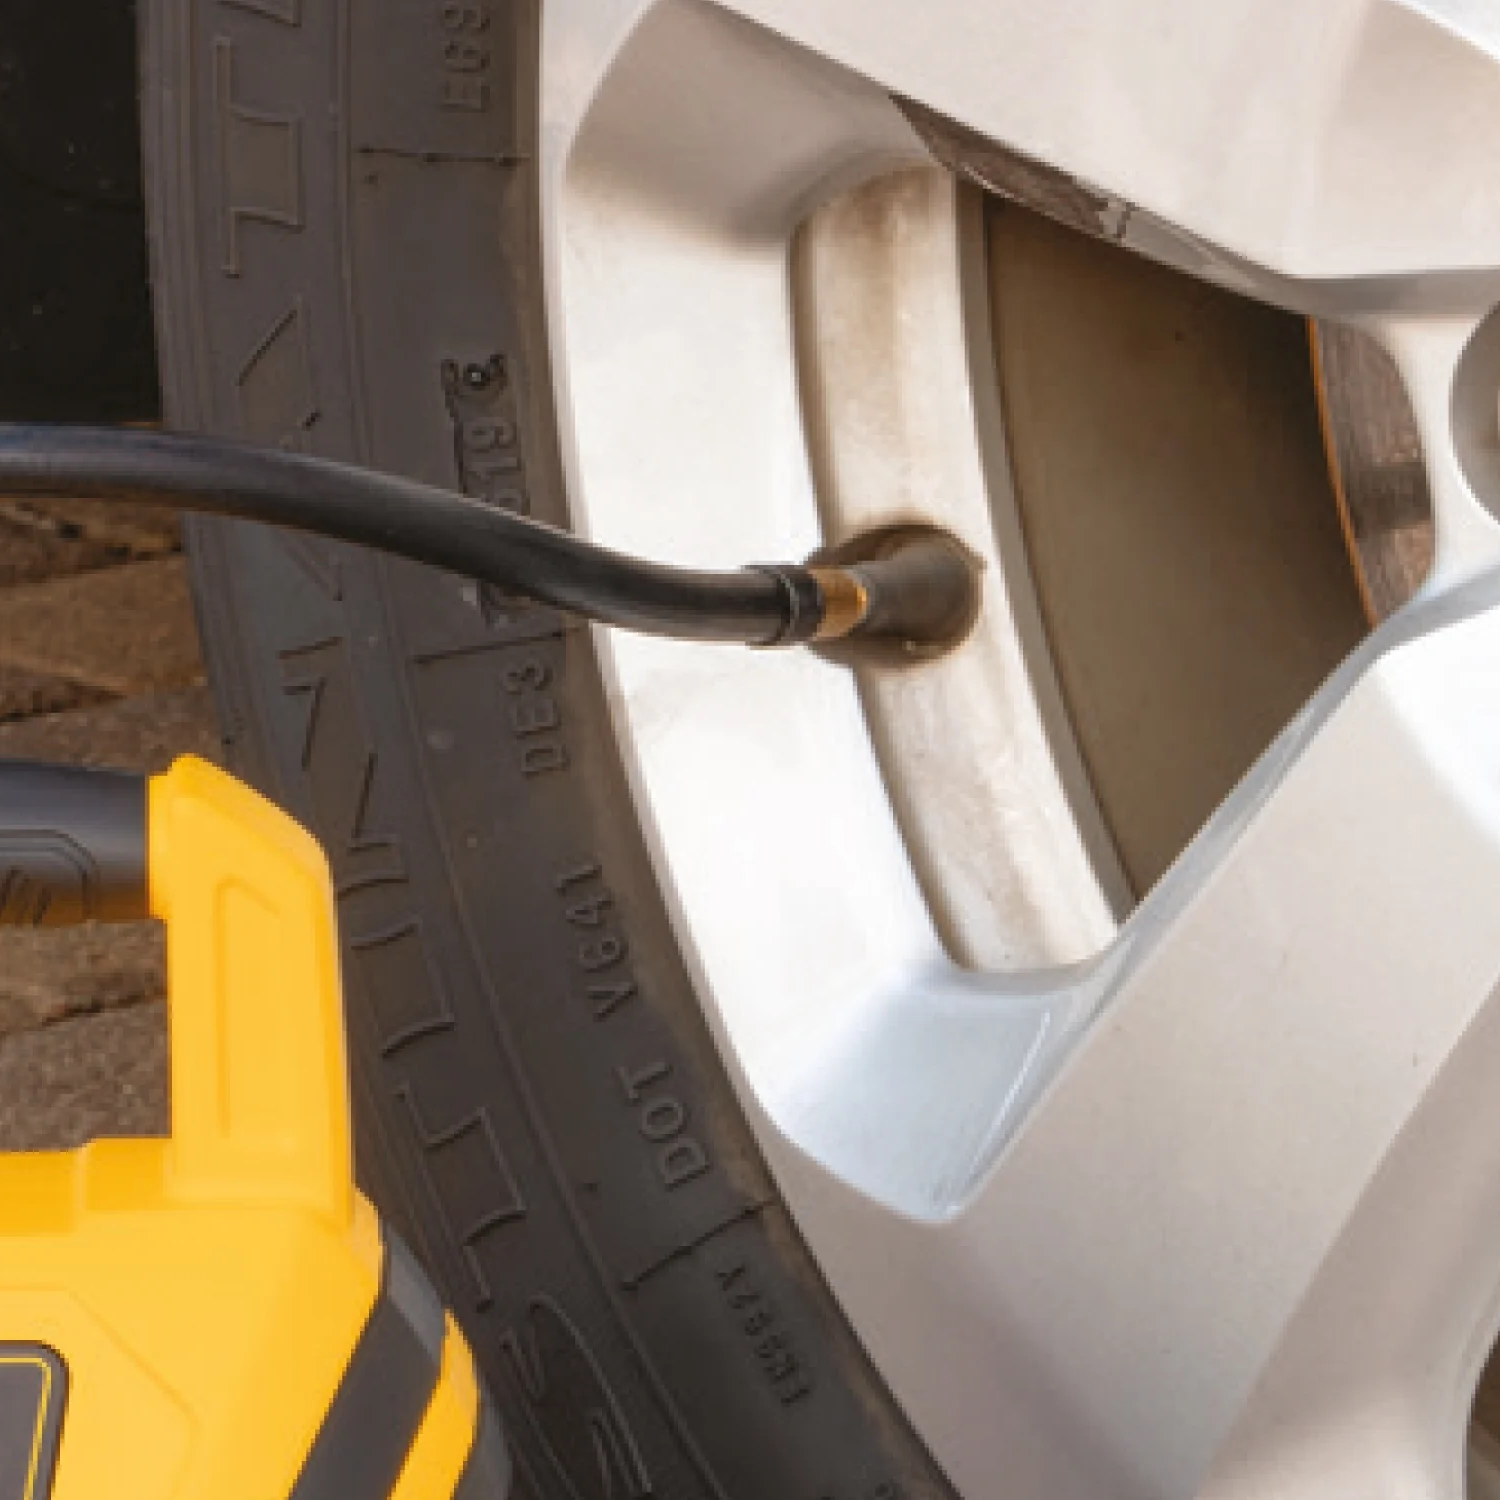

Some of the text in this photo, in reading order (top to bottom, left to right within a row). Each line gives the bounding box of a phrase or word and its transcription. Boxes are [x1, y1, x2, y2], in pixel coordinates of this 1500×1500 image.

[500, 655, 713, 1194] DOT V641 DE3
